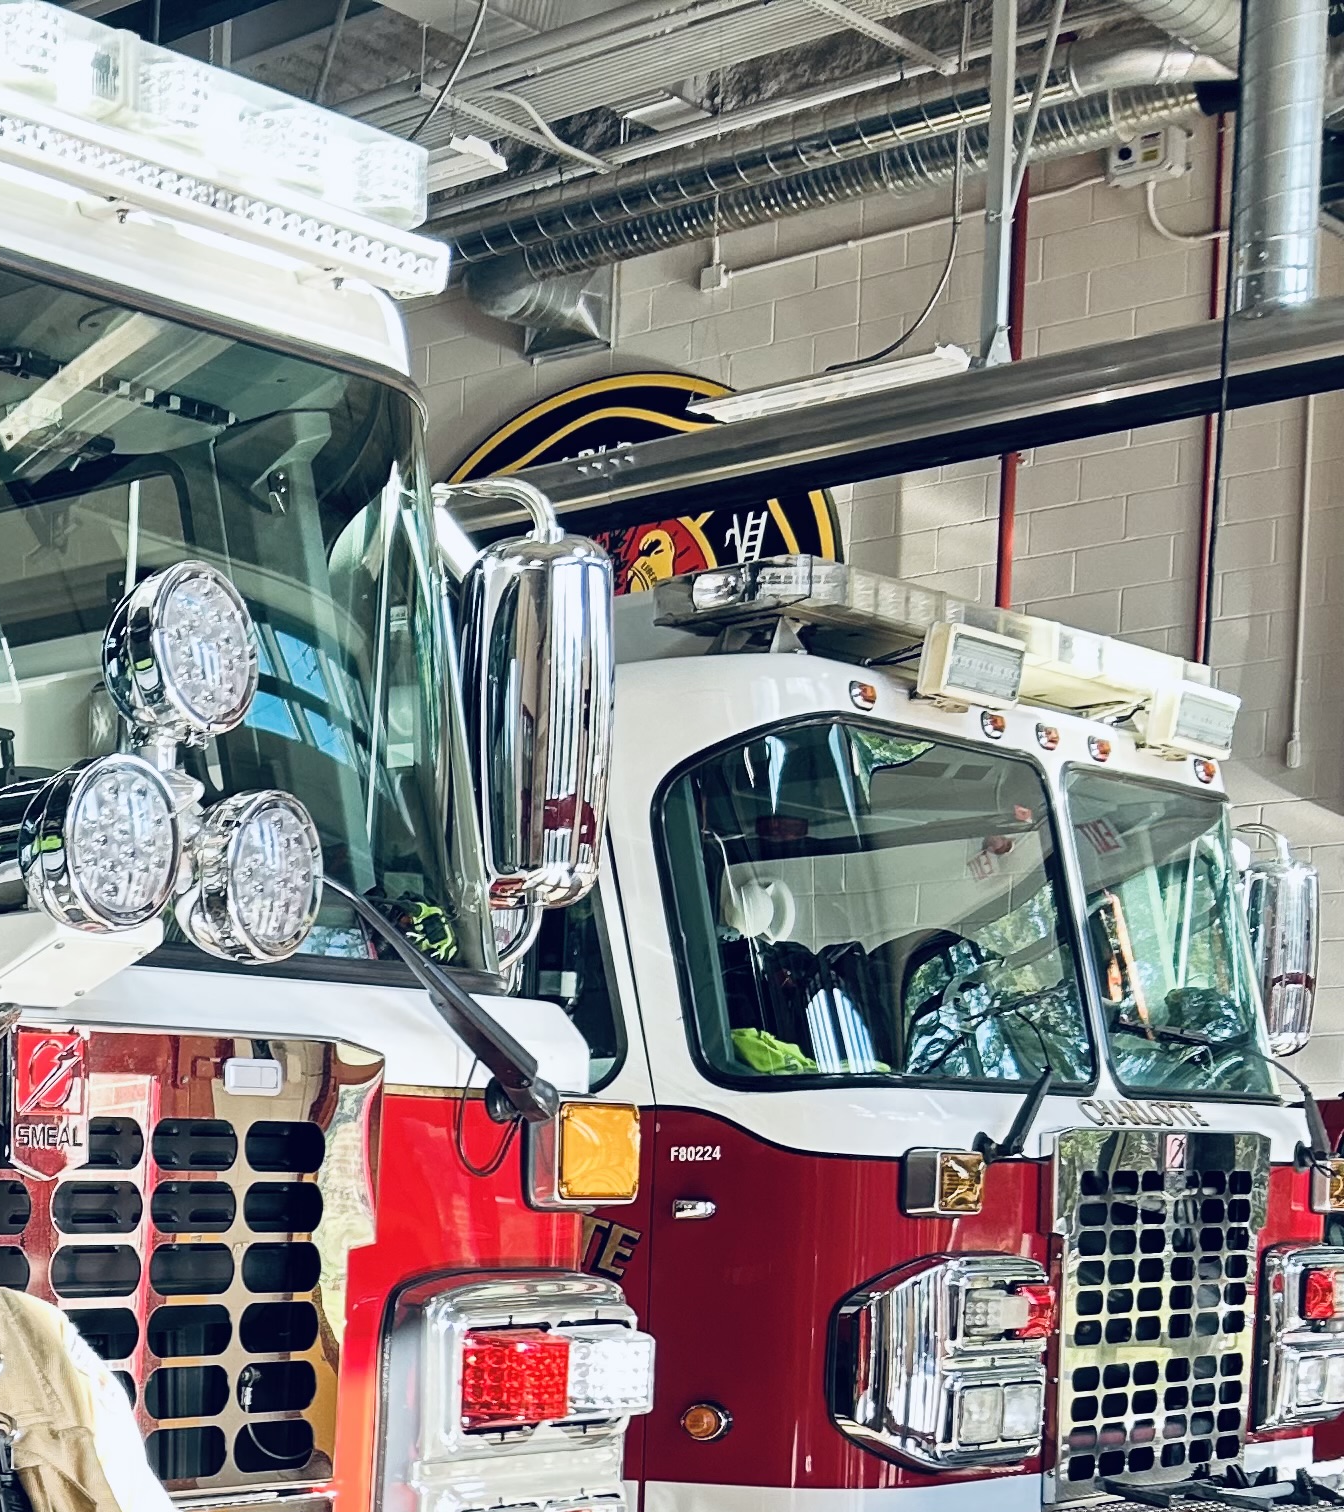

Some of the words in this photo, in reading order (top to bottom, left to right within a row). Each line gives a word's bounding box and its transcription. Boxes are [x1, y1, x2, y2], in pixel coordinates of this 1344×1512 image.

[641, 560, 658, 588] LIBER
[1077, 1099, 1210, 1127] CHARLOTTE
[16, 1124, 84, 1149] SMEAL
[670, 1146, 722, 1162] F80224
